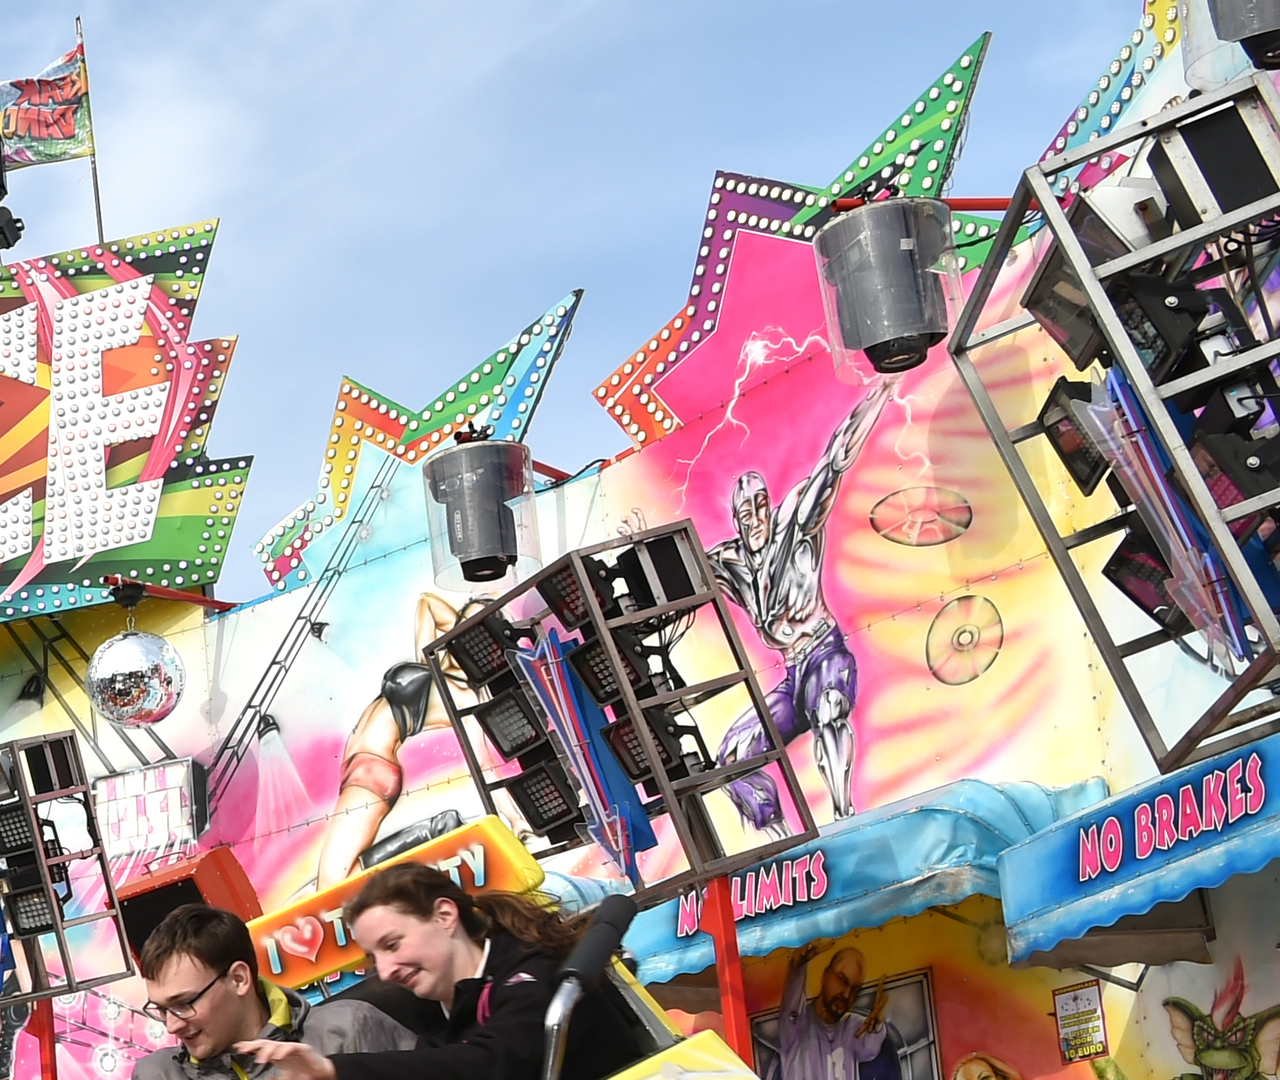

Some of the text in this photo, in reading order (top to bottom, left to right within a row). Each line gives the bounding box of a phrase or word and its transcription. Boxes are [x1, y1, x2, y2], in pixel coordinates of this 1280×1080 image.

[1079, 752, 1266, 883] NO BRAKES
[731, 850, 828, 922] LIMITS
[263, 936, 282, 974] I
[1064, 1043, 1104, 1059] 10 EURO
[1070, 1036, 1094, 1046] VOOR
